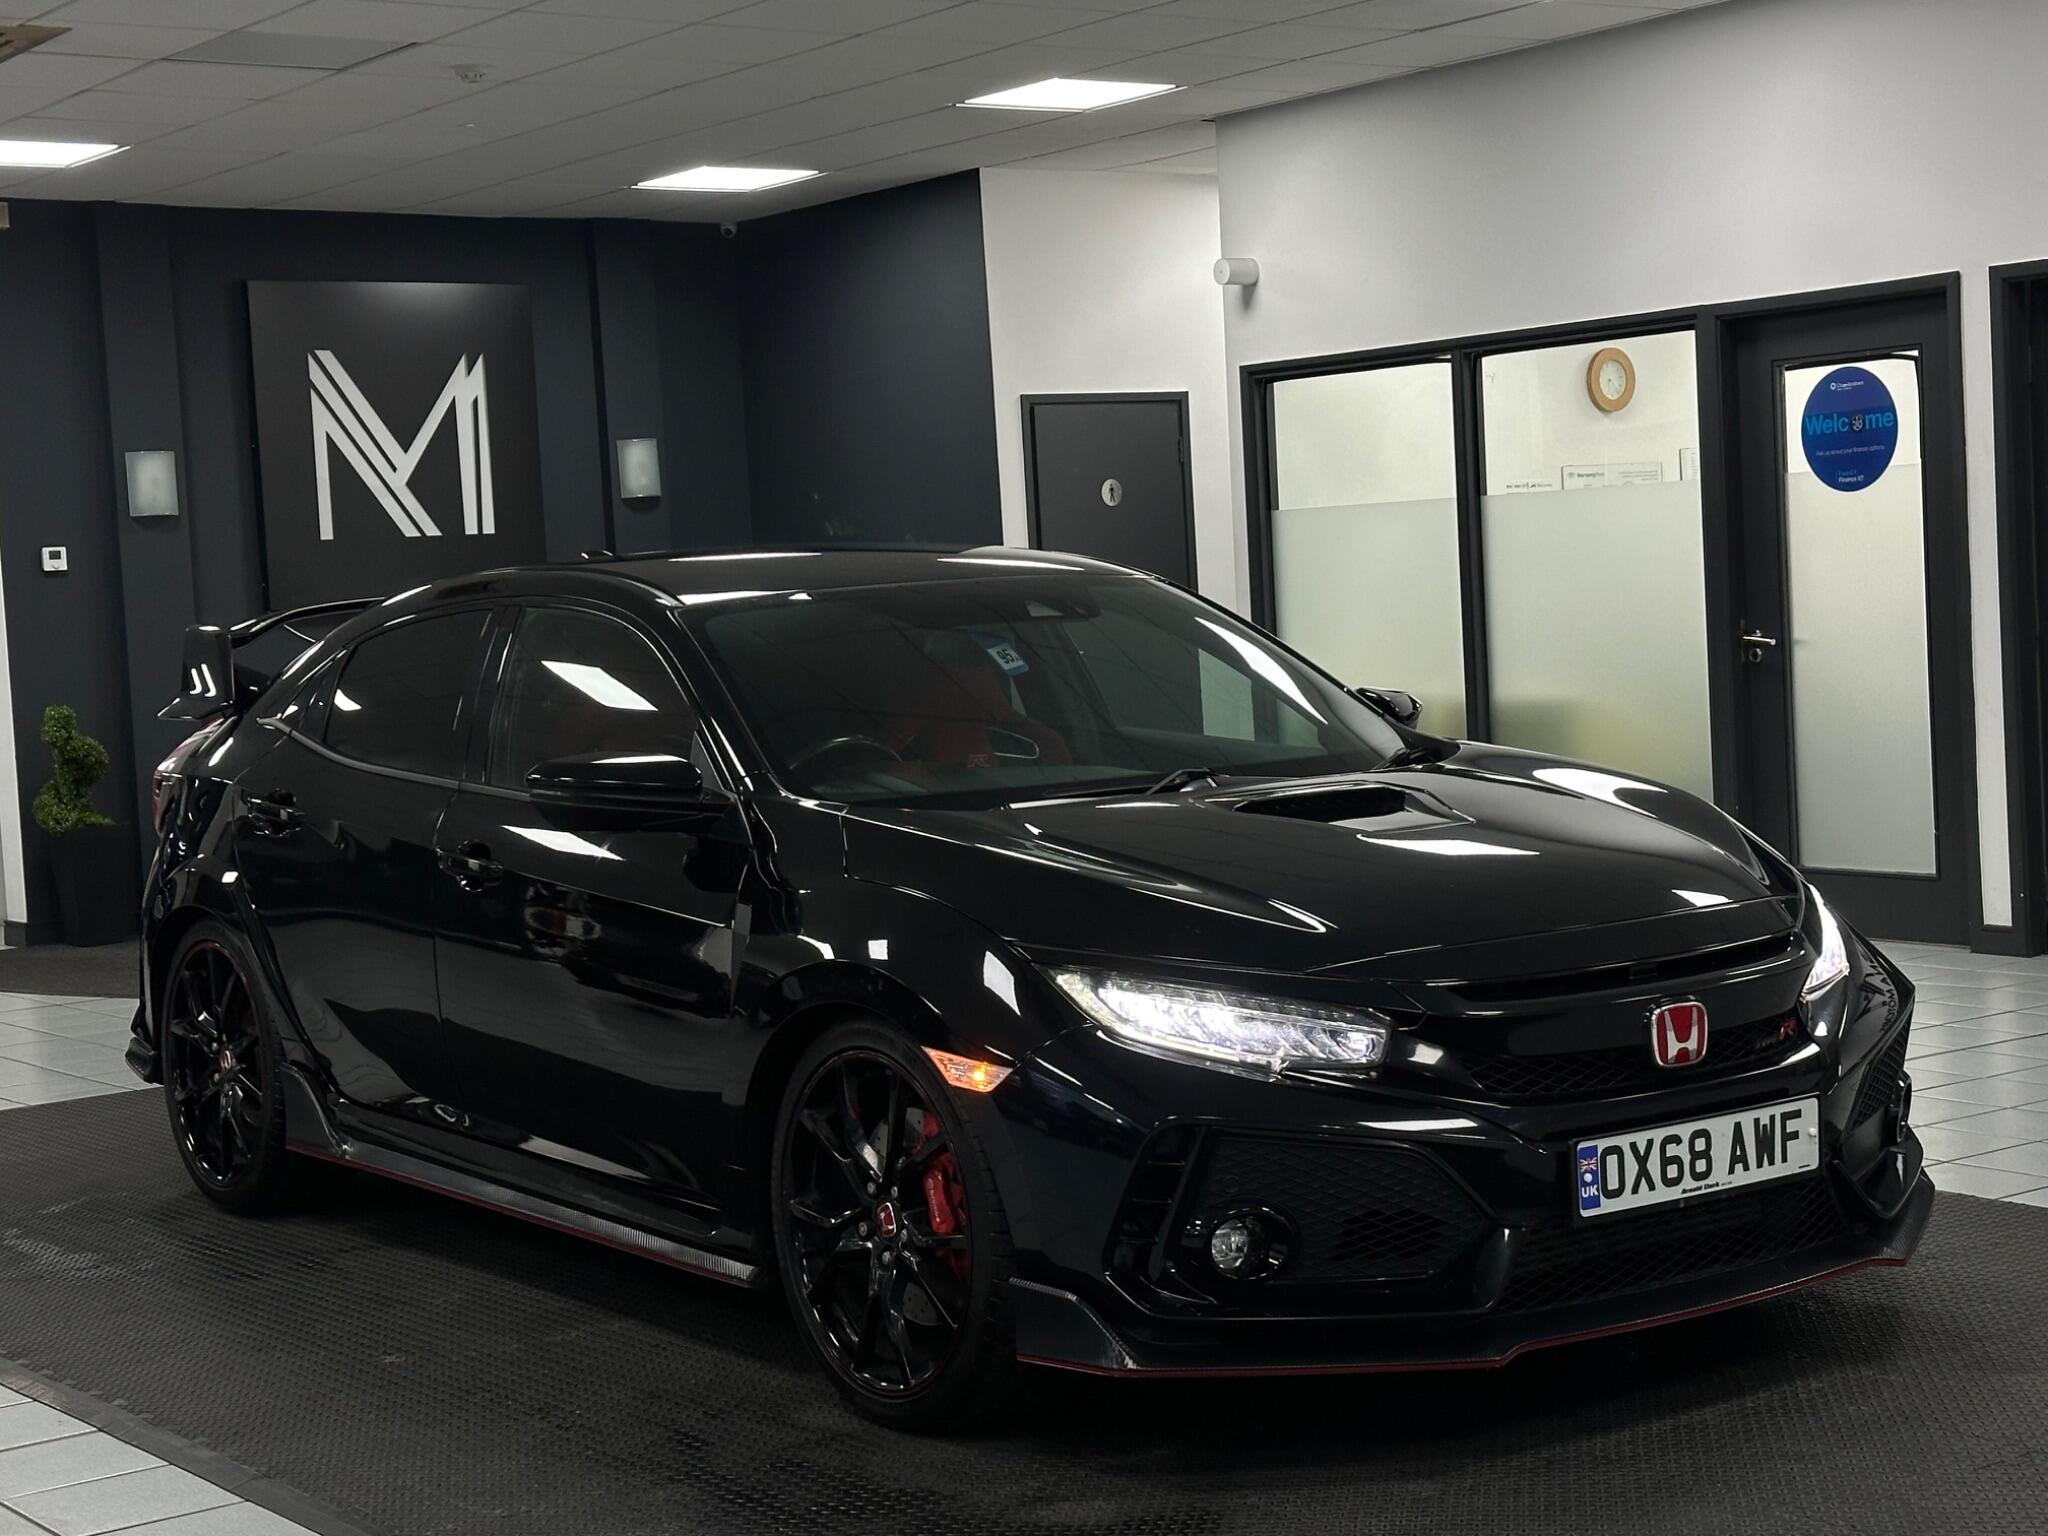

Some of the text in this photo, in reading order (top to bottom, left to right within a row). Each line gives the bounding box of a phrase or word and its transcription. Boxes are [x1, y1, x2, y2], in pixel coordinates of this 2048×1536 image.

[1600, 1108, 1802, 1200] OX68 AWF
[1581, 1184, 1599, 1198] UK
